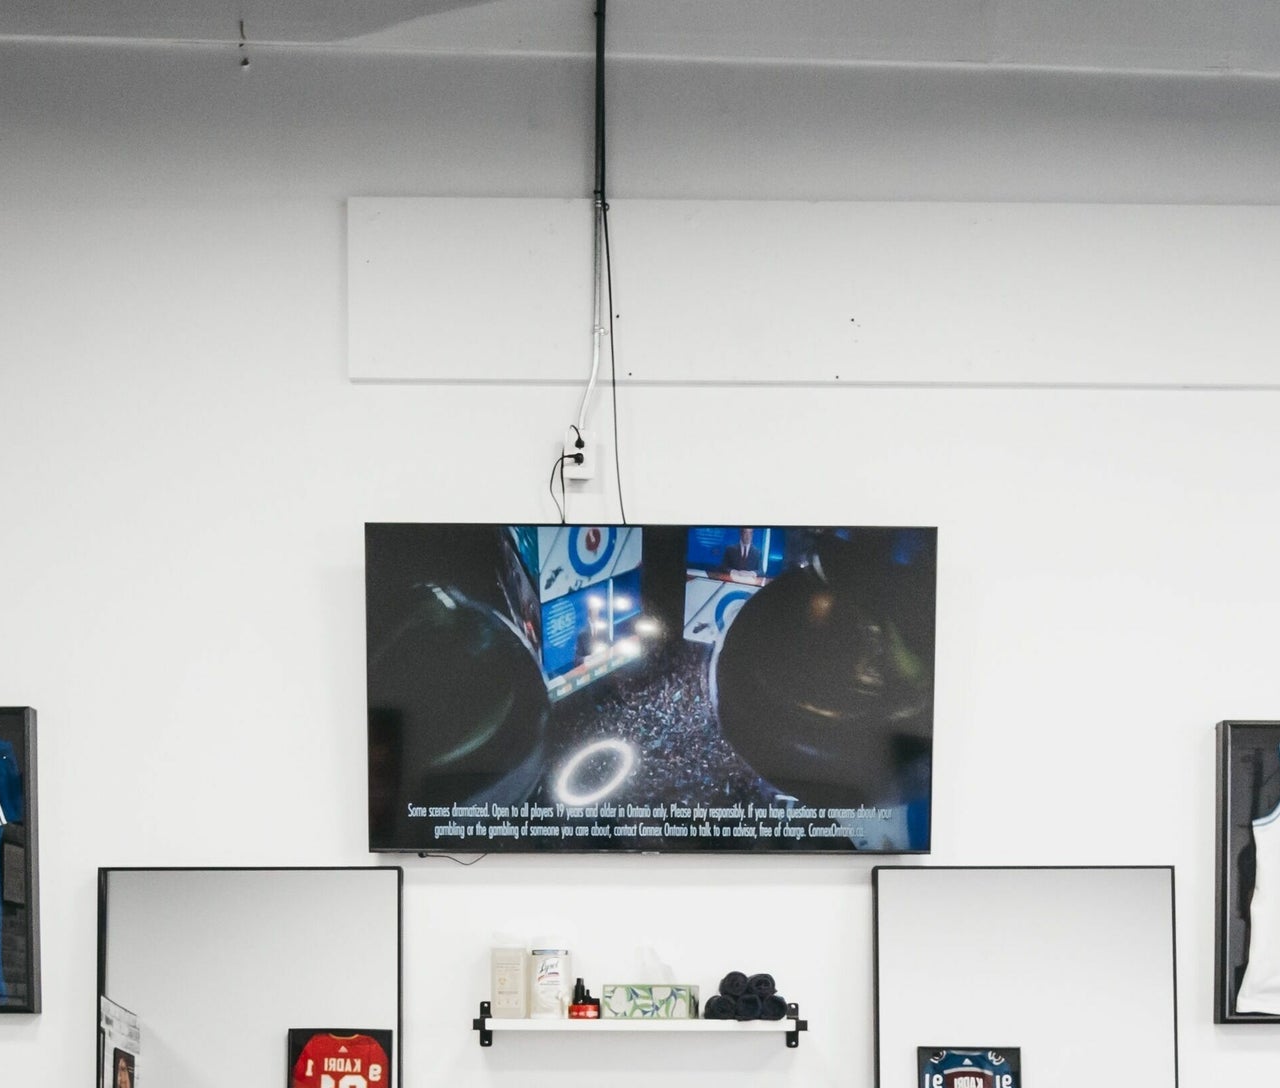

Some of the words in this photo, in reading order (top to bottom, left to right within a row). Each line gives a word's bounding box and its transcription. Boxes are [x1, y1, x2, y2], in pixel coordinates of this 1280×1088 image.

[408, 803, 427, 818] Some
[428, 806, 451, 818] scenes
[492, 803, 510, 820] Open
[511, 805, 519, 818] to
[520, 803, 529, 818] all
[530, 803, 554, 820] players
[556, 803, 565, 818] 19
[566, 807, 584, 820] years
[585, 803, 599, 818] and
[600, 802, 617, 818] older
[618, 804, 625, 818] in
[626, 803, 651, 818] Ontario
[652, 803, 669, 821] only.
[670, 803, 692, 818] Please
[693, 803, 708, 821] play
[709, 803, 746, 821] responsibly.
[747, 803, 754, 818] If
[755, 807, 768, 821] you
[769, 803, 785, 819] have
[786, 805, 817, 821] questions
[856, 804, 876, 819] about
[434, 821, 465, 839] gambling
[475, 821, 487, 836] the
[488, 821, 519, 839] gambling
[520, 821, 529, 836] of
[529, 825, 560, 837] someone
[561, 826, 574, 839] you
[575, 825, 589, 837] care
[638, 822, 663, 837] Connex
[664, 822, 689, 837] Ontario
[689, 824, 697, 837] to
[698, 821, 712, 837] talk
[713, 824, 721, 837] to
[759, 822, 772, 837] free
[773, 822, 782, 837] of
[783, 822, 807, 840] charge.
